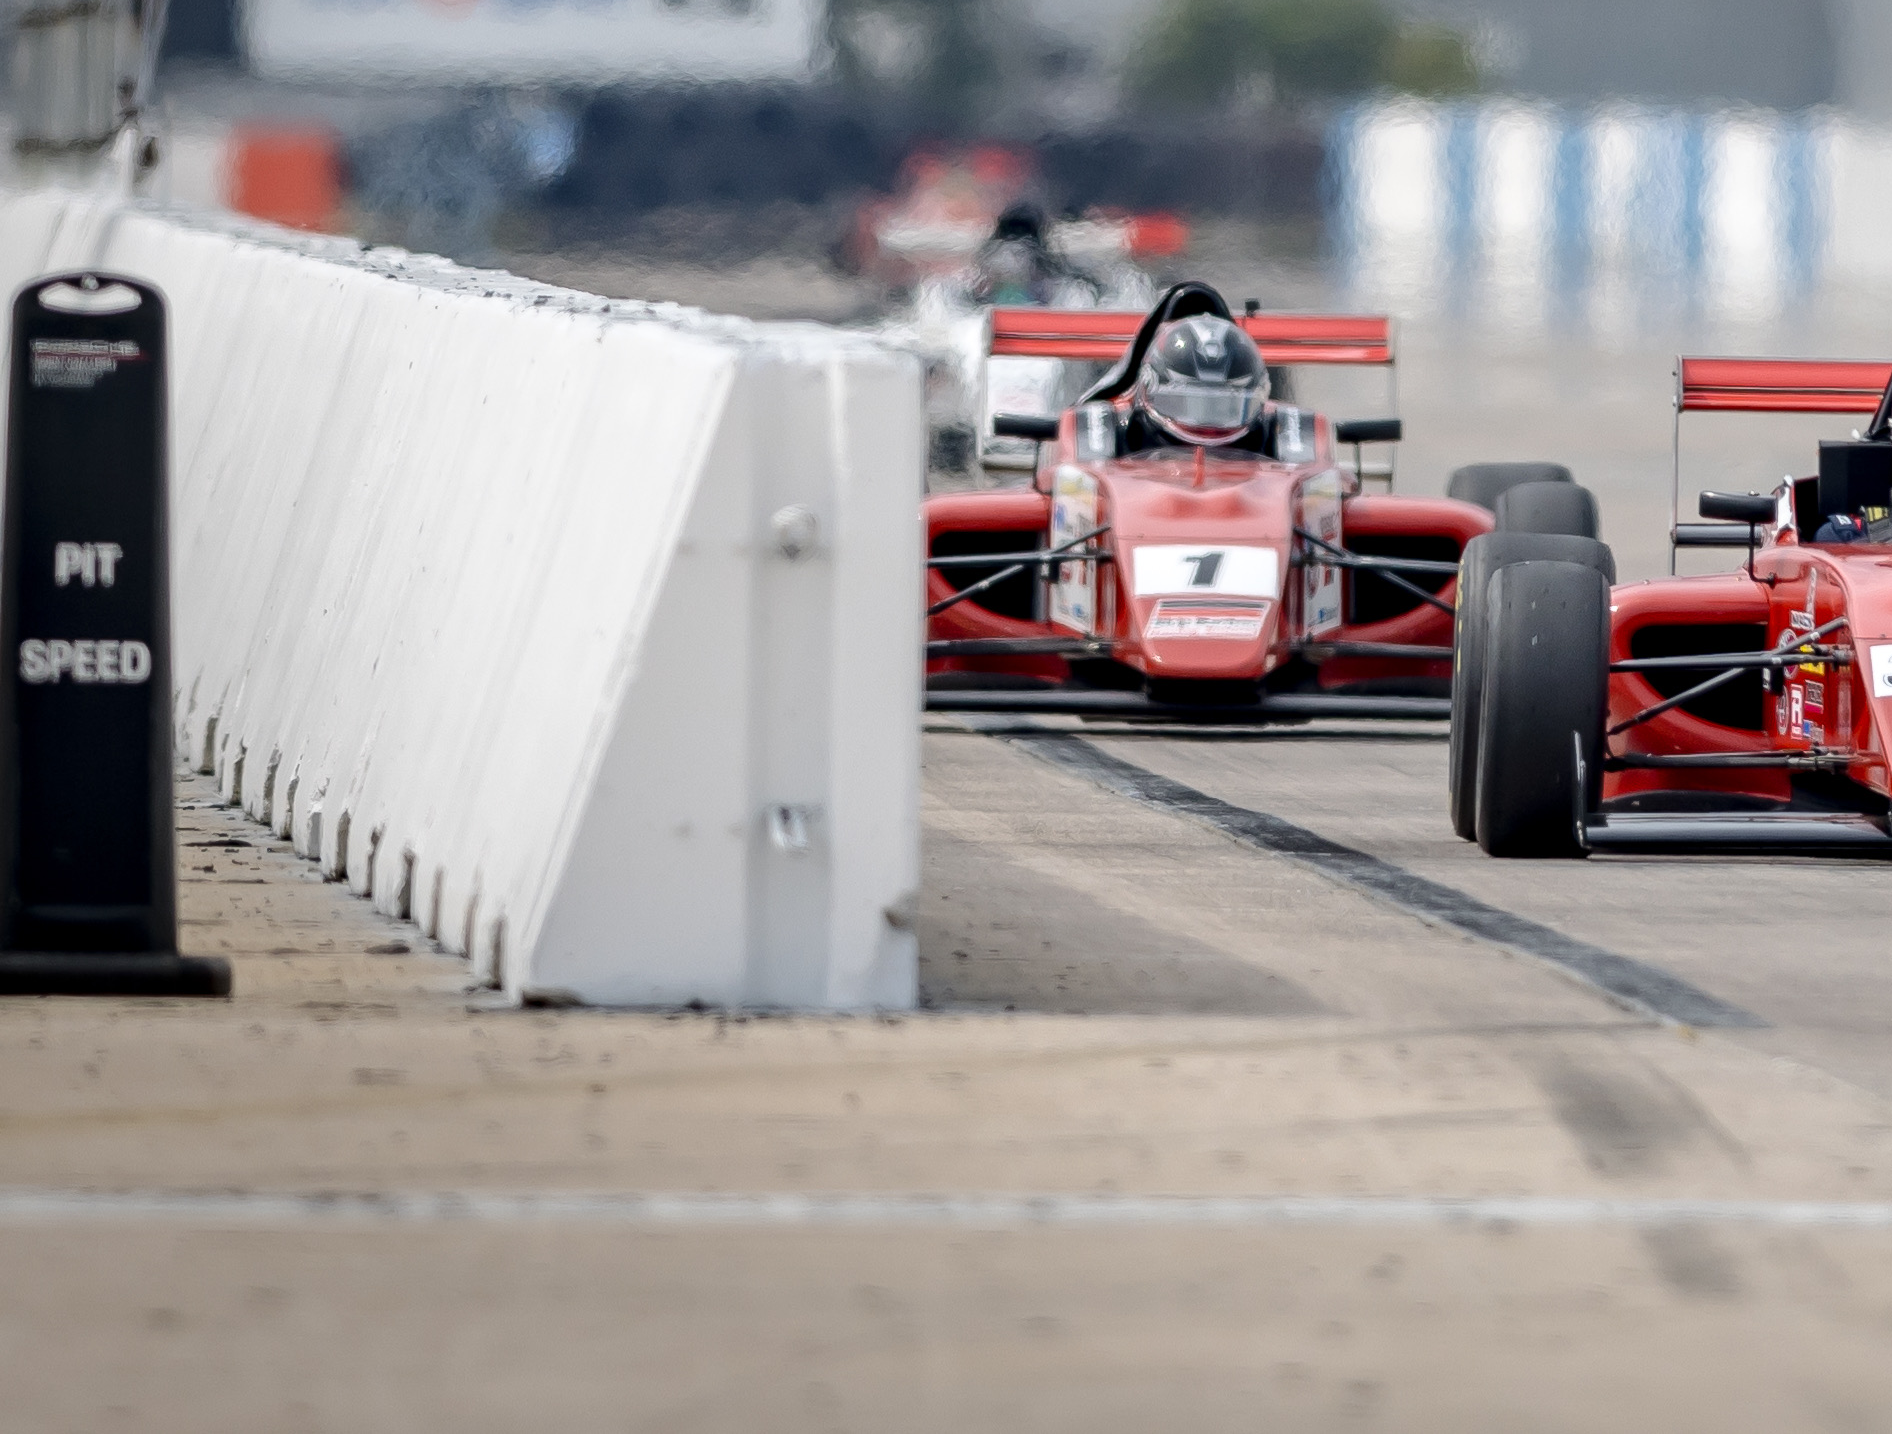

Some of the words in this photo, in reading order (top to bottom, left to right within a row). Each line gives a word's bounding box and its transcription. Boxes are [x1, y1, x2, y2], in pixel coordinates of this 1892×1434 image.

[55, 541, 121, 587] PIT
[1184, 551, 1225, 588] 1
[20, 639, 151, 684] SPEED
